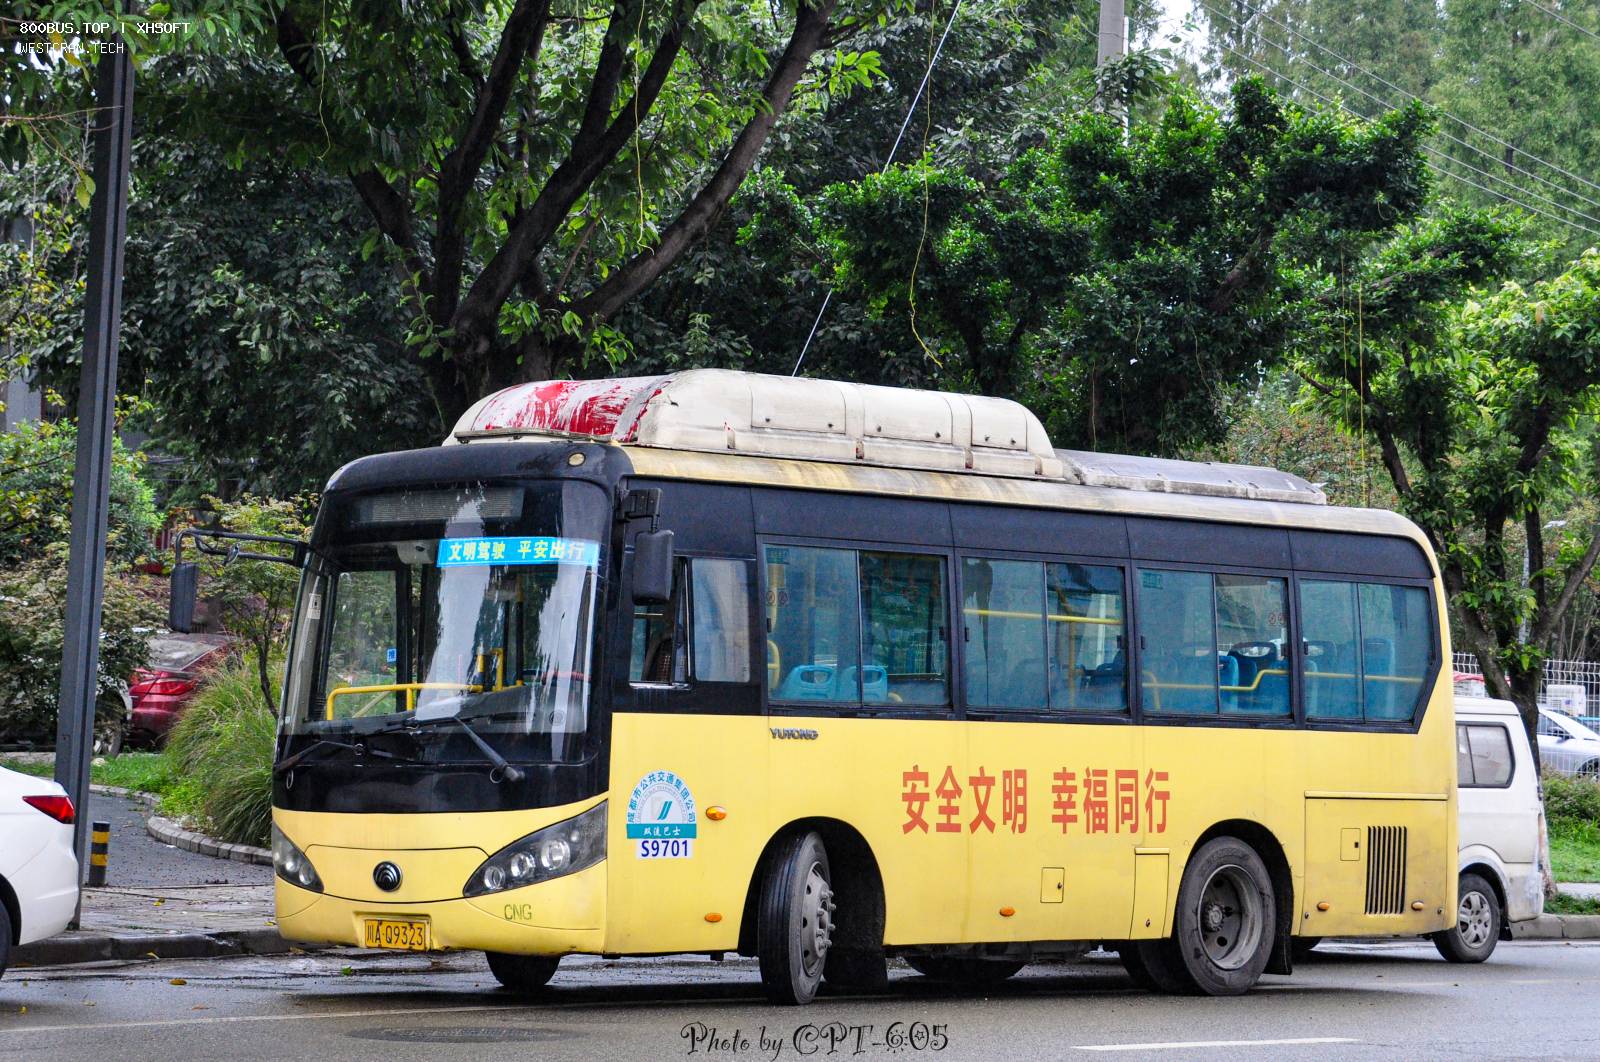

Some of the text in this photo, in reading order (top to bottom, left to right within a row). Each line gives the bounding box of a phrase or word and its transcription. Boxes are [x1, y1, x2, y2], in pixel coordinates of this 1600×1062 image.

[448, 540, 586, 560] 文明驾驶 平安出行
[769, 727, 819, 741] YUTONG
[901, 764, 1171, 835] 安全文明 幸福同行
[641, 839, 689, 858] S9701
[504, 904, 532, 920] CNG
